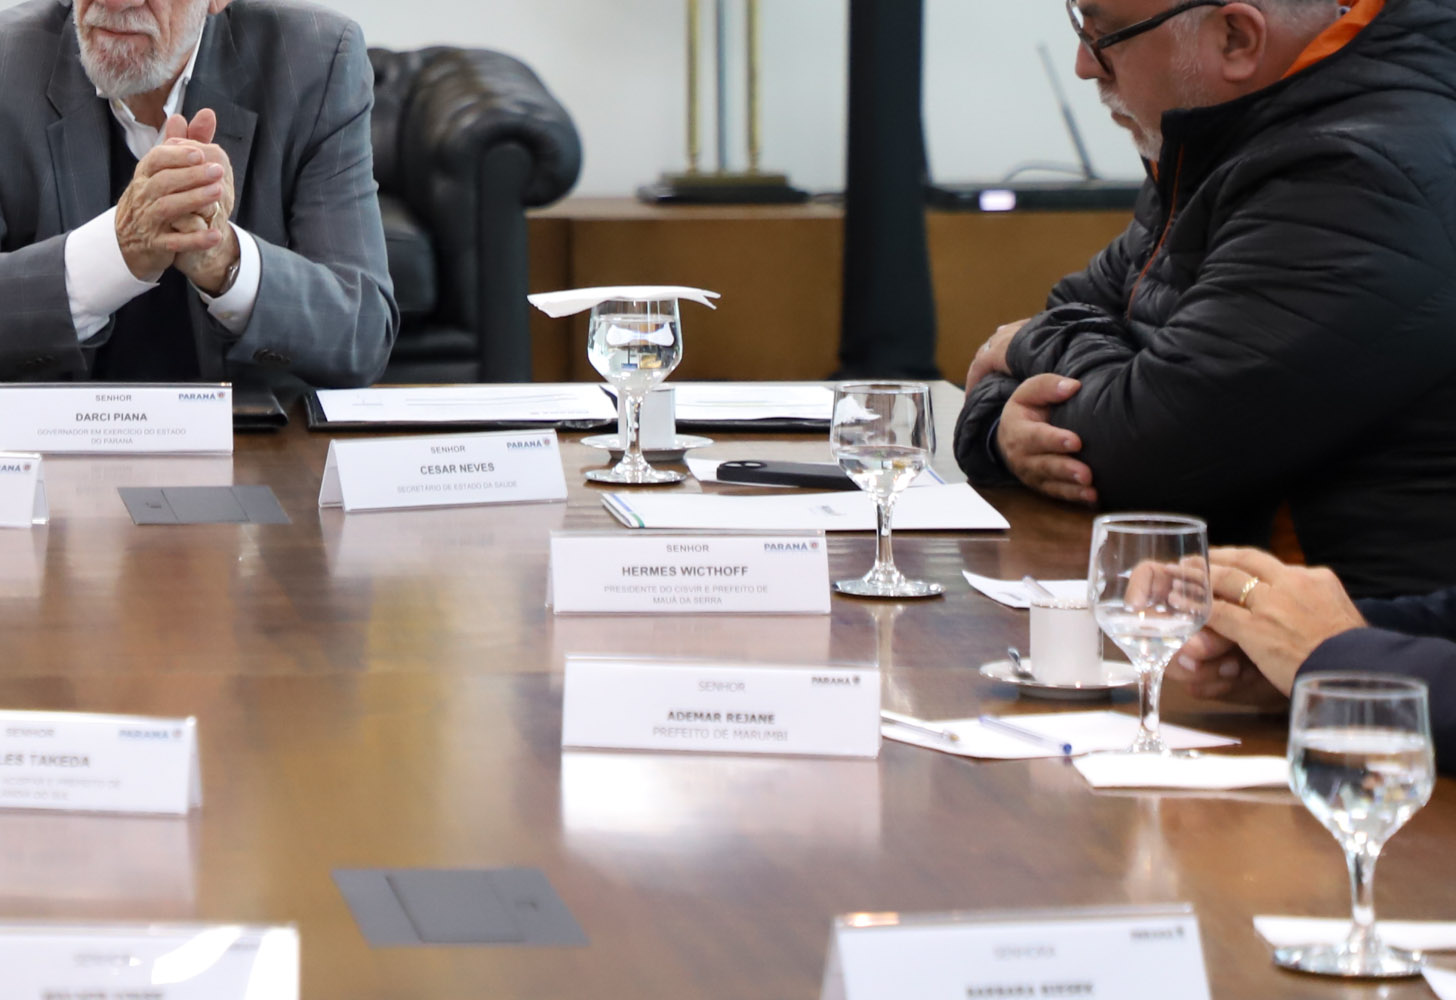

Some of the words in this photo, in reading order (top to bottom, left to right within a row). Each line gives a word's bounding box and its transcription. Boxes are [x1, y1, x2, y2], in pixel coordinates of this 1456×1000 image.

[95, 394, 133, 402] SENHOR
[178, 391, 216, 400] PARANÁ
[75, 412, 111, 422] DARCI
[113, 412, 148, 422] PIANA
[37, 428, 89, 436] GOVERNADOR
[90, 428, 102, 436] EM
[144, 428, 155, 436] DO
[156, 428, 187, 436] ESTADO
[506, 439, 542, 449] PARANÁ
[430, 445, 466, 454] SENHOR
[420, 464, 457, 475] CESAR
[459, 462, 495, 473] NEVES
[453, 482, 481, 491] ESTADO
[483, 481, 493, 489] DA
[666, 544, 710, 553] SENHOR
[764, 541, 808, 551] PARANÁ
[622, 566, 677, 577] HERMES
[680, 566, 749, 577] WICTHOFF
[603, 585, 657, 593] PRESIDENTE
[659, 585, 672, 593] DO
[674, 585, 702, 593] CISVIR
[712, 585, 755, 593] PREFEITO
[757, 585, 769, 593] DE
[679, 596, 692, 605] DA
[693, 596, 723, 605] SERRA
[698, 680, 746, 692] SENHOR
[667, 710, 721, 723] ADEMAR
[726, 712, 775, 725] REJANE
[5, 727, 55, 738] SENHOR
[652, 726, 709, 739] PREFEITO
[713, 728, 729, 739] DE
[733, 730, 788, 742] MARUMBI
[30, 753, 91, 768] TAKEDA
